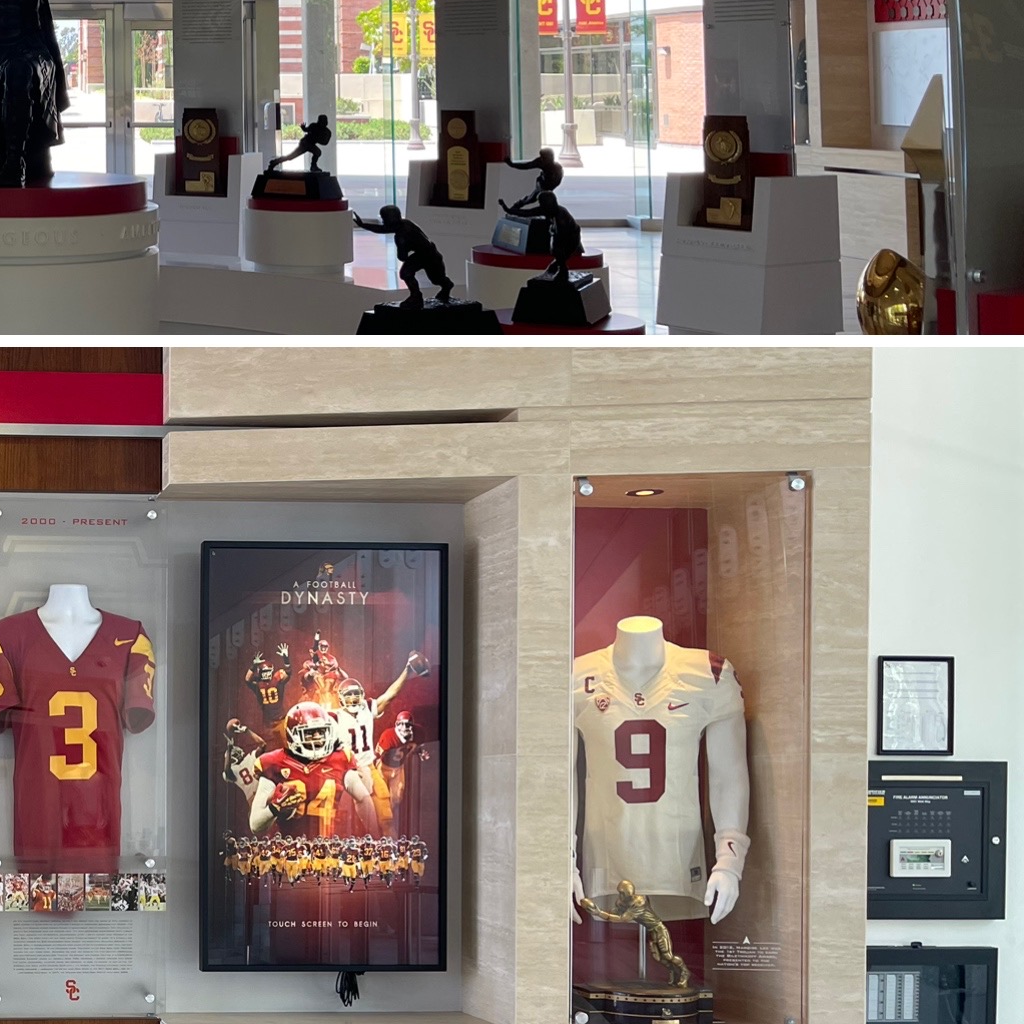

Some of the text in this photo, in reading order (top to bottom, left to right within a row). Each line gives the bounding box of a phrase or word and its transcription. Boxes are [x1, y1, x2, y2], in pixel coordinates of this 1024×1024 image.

[21, 517, 57, 525] 2000
[72, 518, 129, 526] PRESENT
[306, 581, 356, 589] FOOTBALL
[281, 591, 369, 605] DYNASTY
[584, 676, 596, 694] C
[260, 687, 279, 705] 10
[634, 692, 645, 706] SC
[48, 691, 98, 780] 3
[348, 725, 371, 754] 11
[614, 719, 666, 804] 9
[239, 767, 253, 785] 8
[268, 920, 378, 928] TOUCH SCREEN TO BEGIN
[65, 979, 80, 1001] SC
